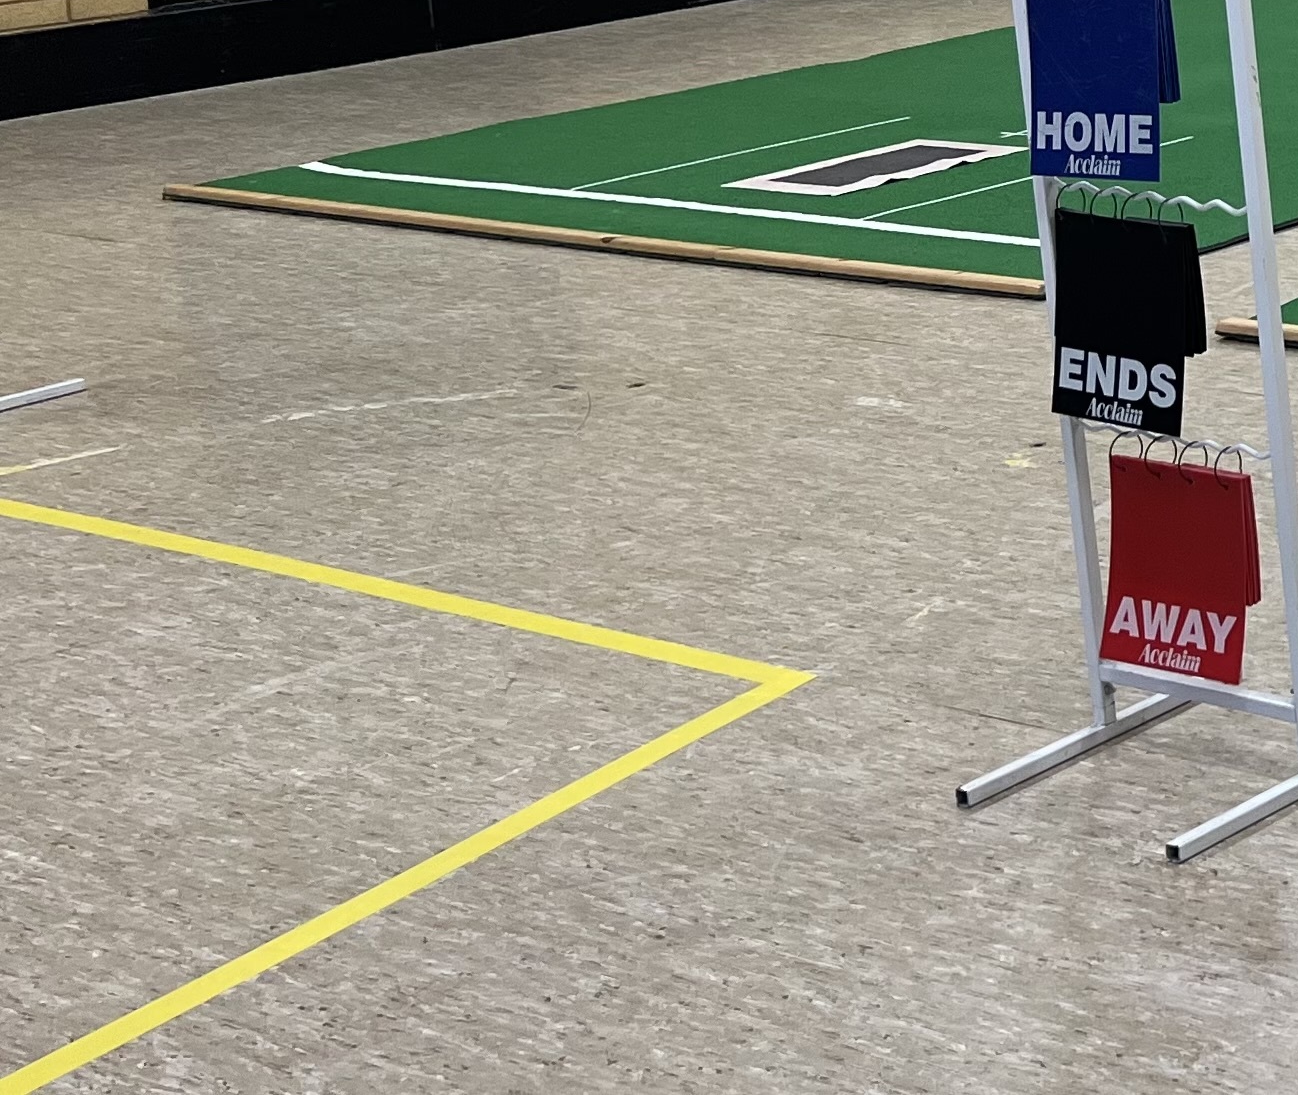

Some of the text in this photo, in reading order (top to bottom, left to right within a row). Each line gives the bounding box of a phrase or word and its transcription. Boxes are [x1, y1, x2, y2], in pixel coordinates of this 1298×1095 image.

[1036, 111, 1154, 154] HOME
[1065, 154, 1121, 176] Acclaim
[1058, 346, 1178, 409] ENDS
[1085, 396, 1144, 426] Acclaim
[1109, 595, 1237, 654] AWAY
[1138, 643, 1201, 673] Acclaim
